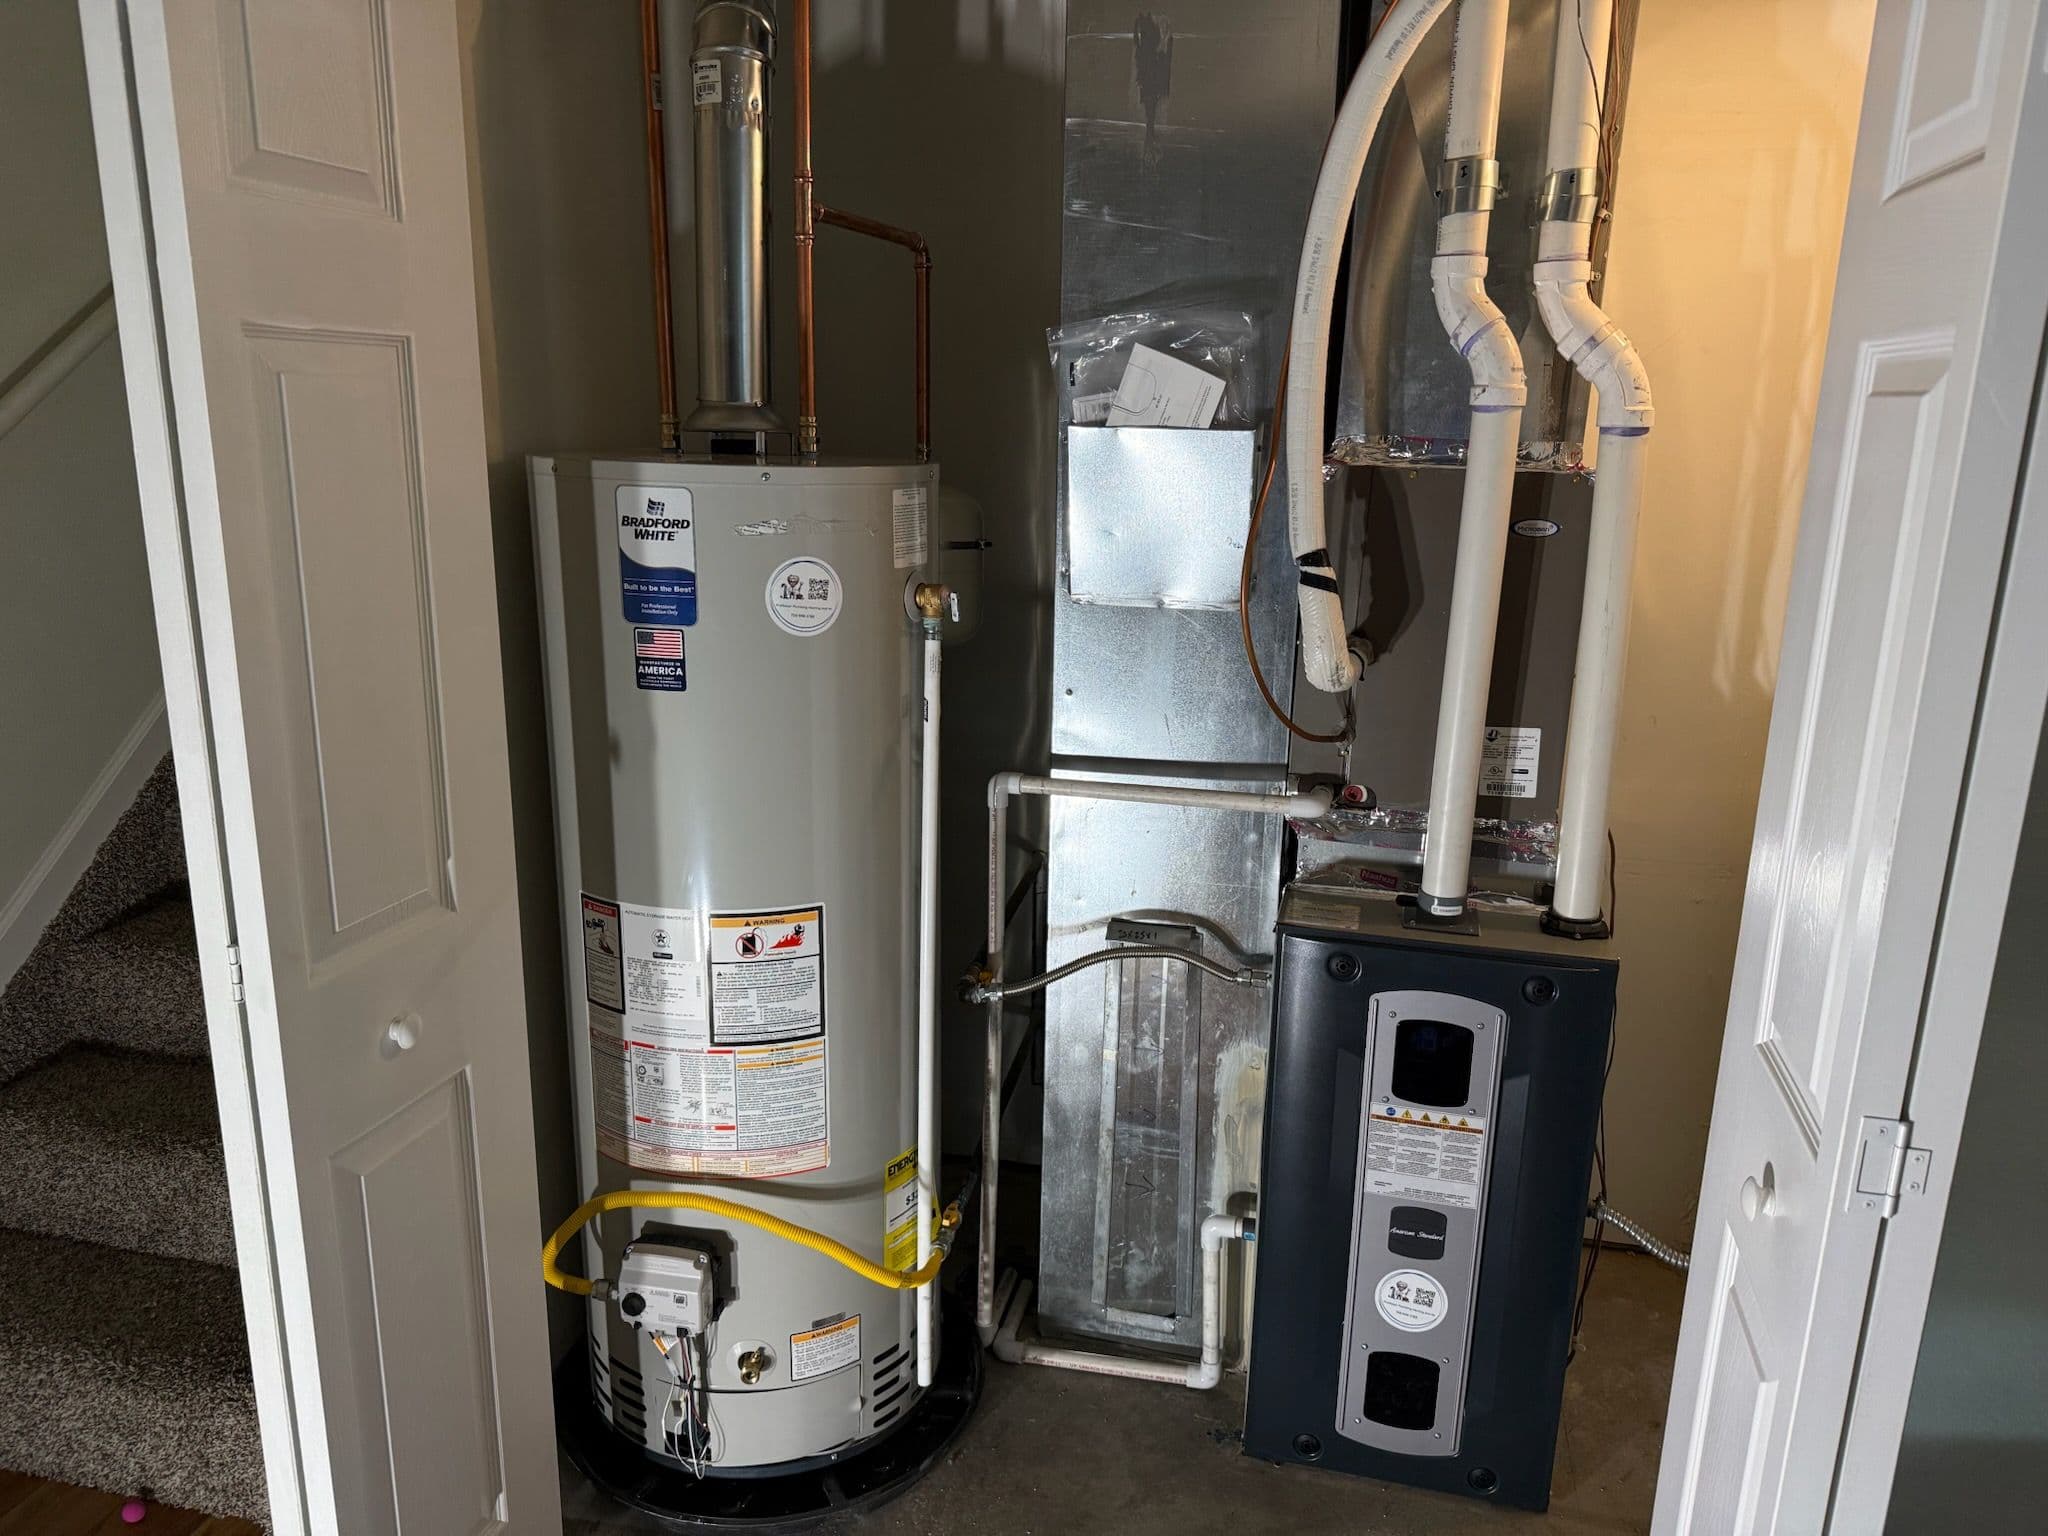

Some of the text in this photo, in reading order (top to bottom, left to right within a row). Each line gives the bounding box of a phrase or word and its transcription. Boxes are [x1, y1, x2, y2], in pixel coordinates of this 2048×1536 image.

[621, 515, 690, 529] BRADFORD
[634, 528, 676, 541] WHITE
[624, 583, 639, 591] Built
[660, 585, 673, 593] the
[638, 665, 684, 676] AMERICA
[1389, 1226, 1445, 1241] American Standard
